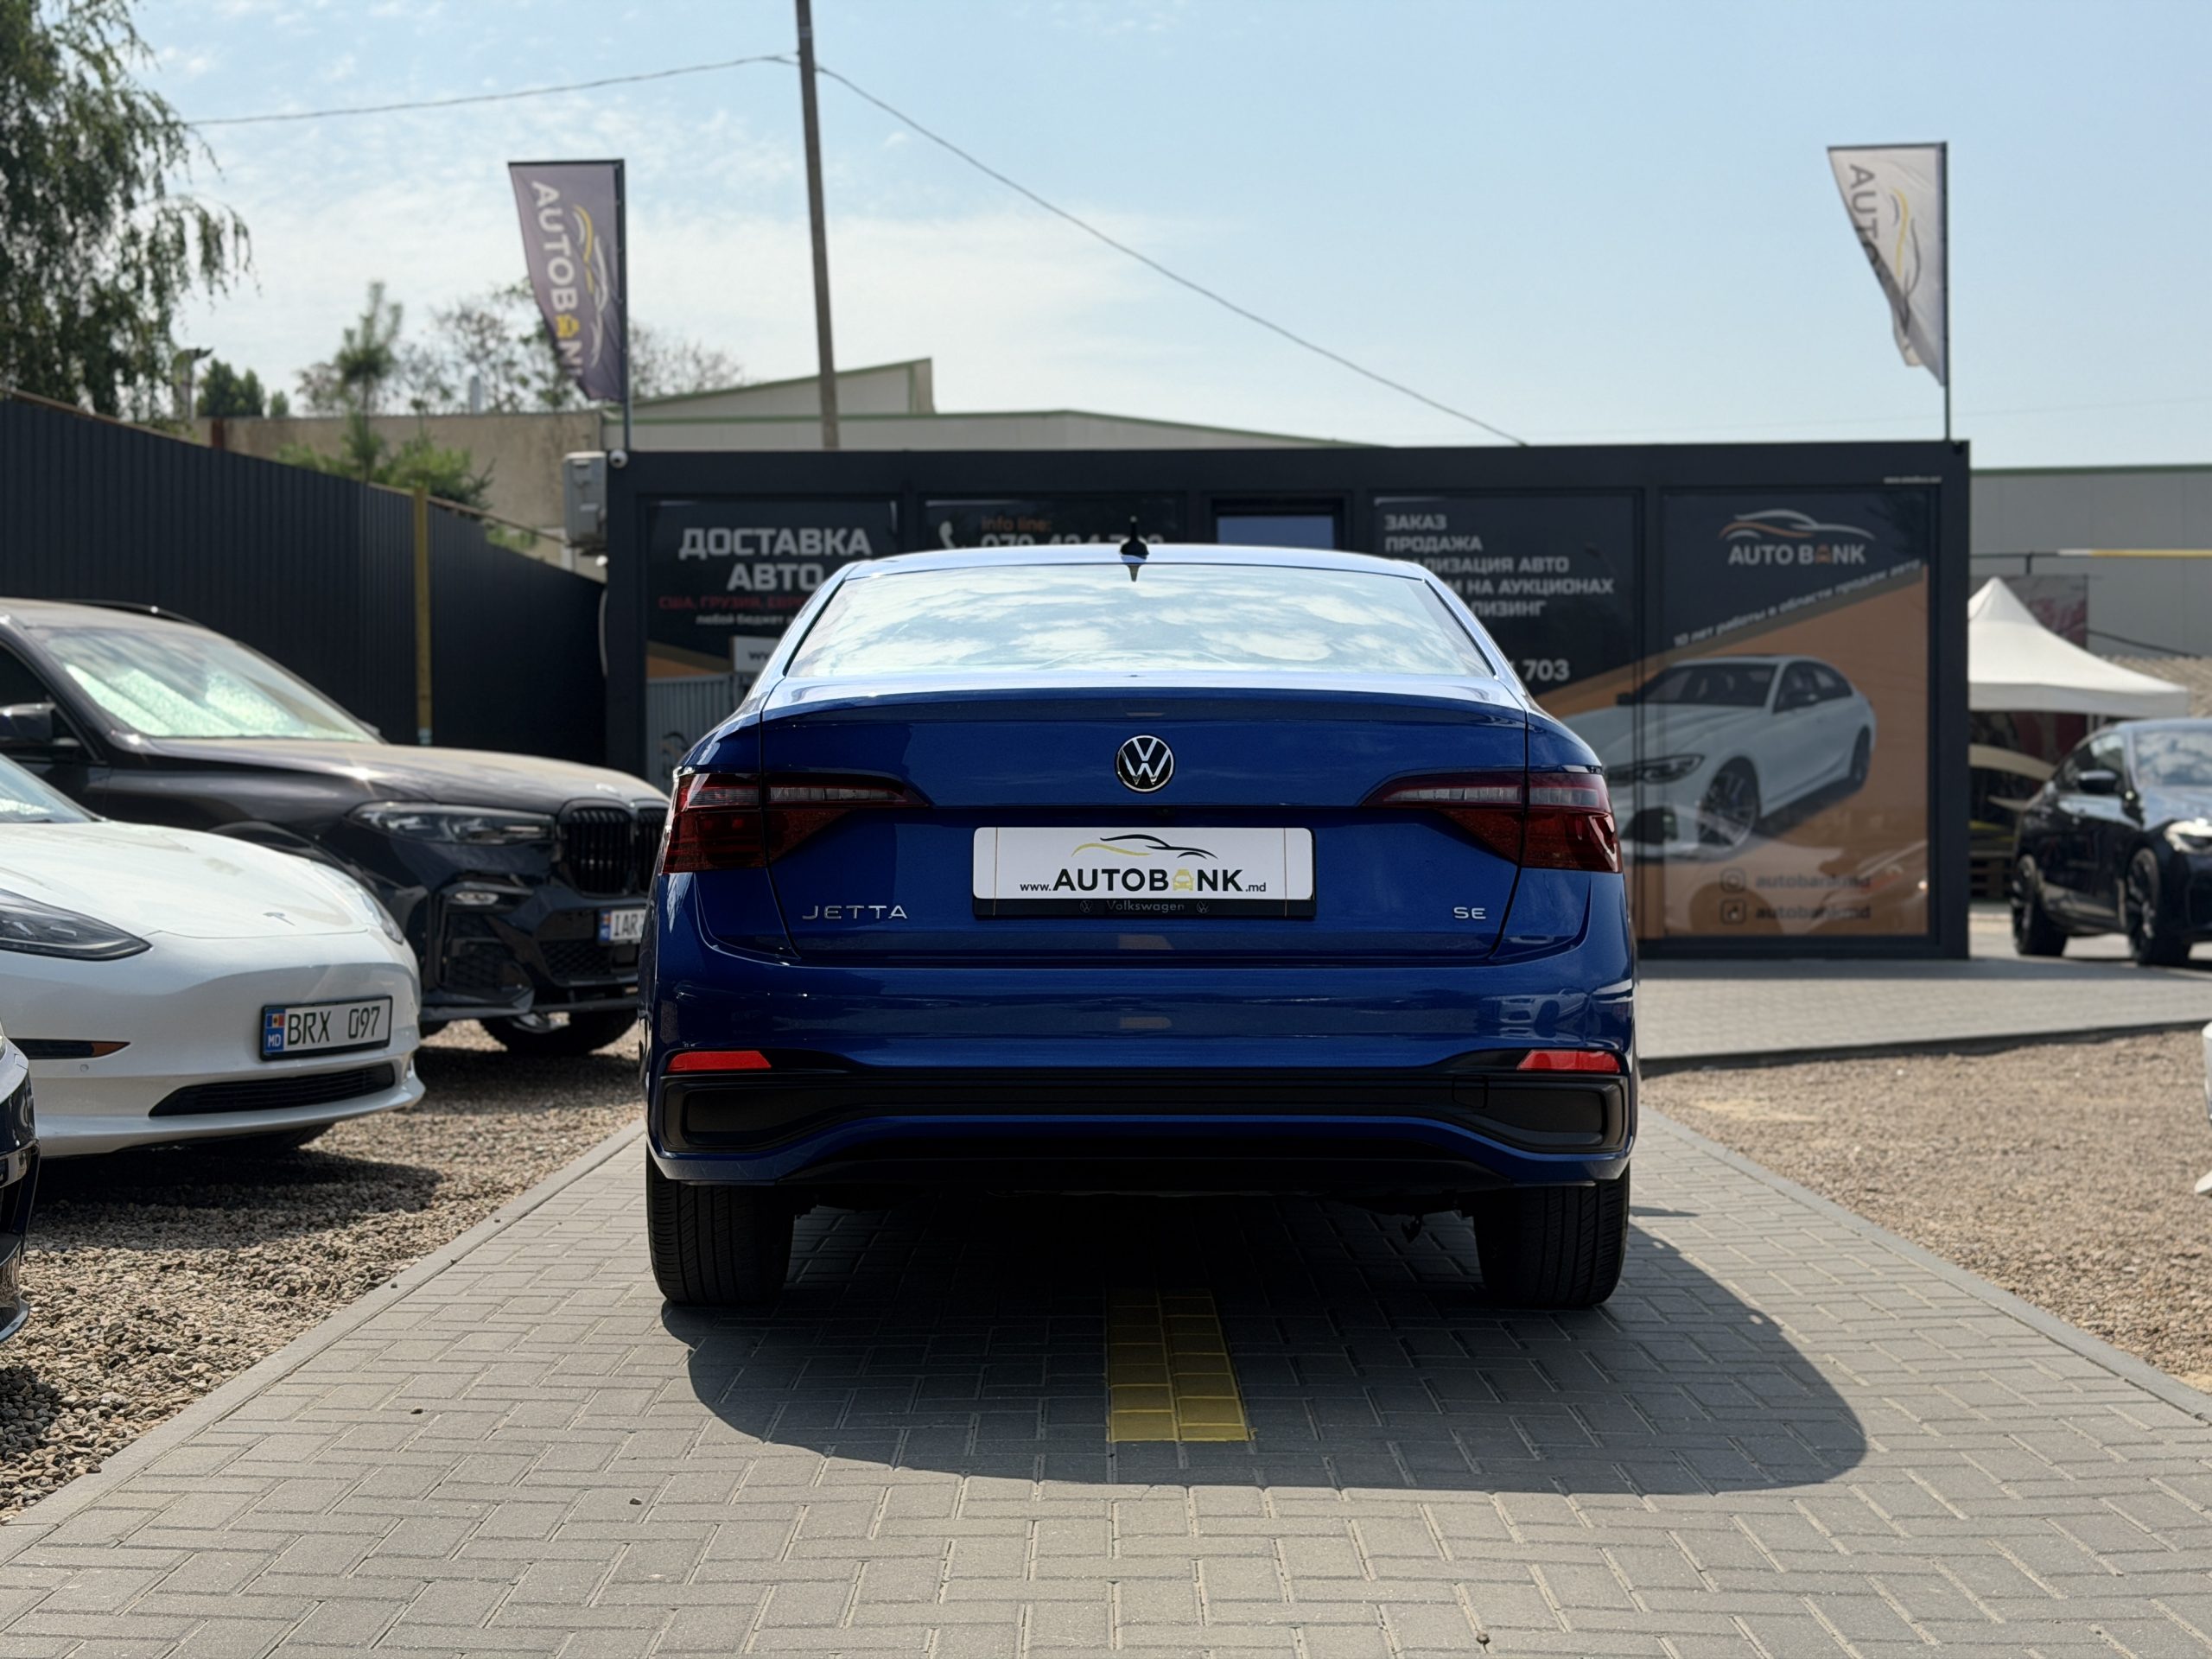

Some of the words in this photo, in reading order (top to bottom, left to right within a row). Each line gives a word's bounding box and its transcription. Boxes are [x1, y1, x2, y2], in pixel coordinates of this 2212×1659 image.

[1385, 515, 1446, 531] ЗАКАЗ
[678, 528, 872, 560] ДОСТАВКА
[1385, 537, 1483, 553] ПРОДАЖА
[1728, 545, 1793, 564] AUTO
[1798, 544, 1866, 564] BANK
[1518, 557, 1570, 573] АВТО
[727, 563, 824, 591] АВТО
[1466, 580, 1493, 594] НА
[1498, 580, 1614, 596] АУКЦИОНАХ
[1471, 601, 1547, 617] ЛИЗИНГ
[1522, 659, 1570, 681] 703
[802, 905, 908, 919] JETTA
[1106, 899, 1185, 914] Volkswagen
[1453, 906, 1487, 919] SE
[287, 1010, 332, 1046] BRX
[347, 1005, 381, 1039] 097
[267, 1033, 282, 1048] MD
